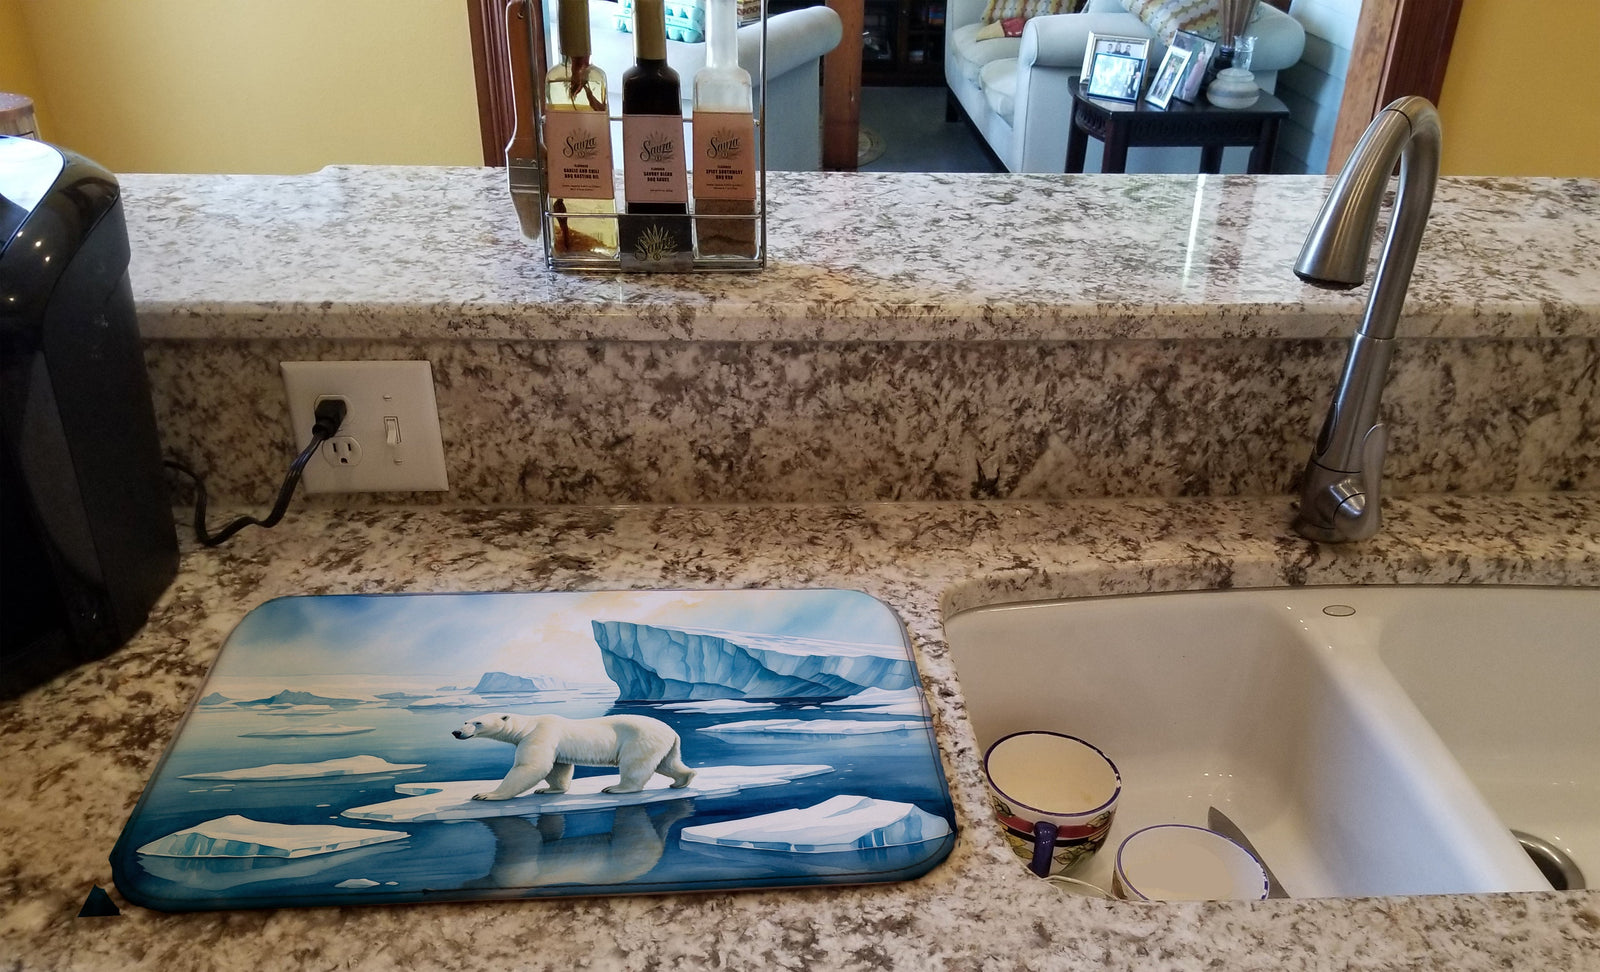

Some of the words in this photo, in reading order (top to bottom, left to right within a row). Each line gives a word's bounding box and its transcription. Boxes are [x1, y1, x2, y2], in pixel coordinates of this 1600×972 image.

[562, 135, 597, 158] Sauza
[640, 139, 674, 161] Sauza
[706, 136, 741, 159] Sauza
